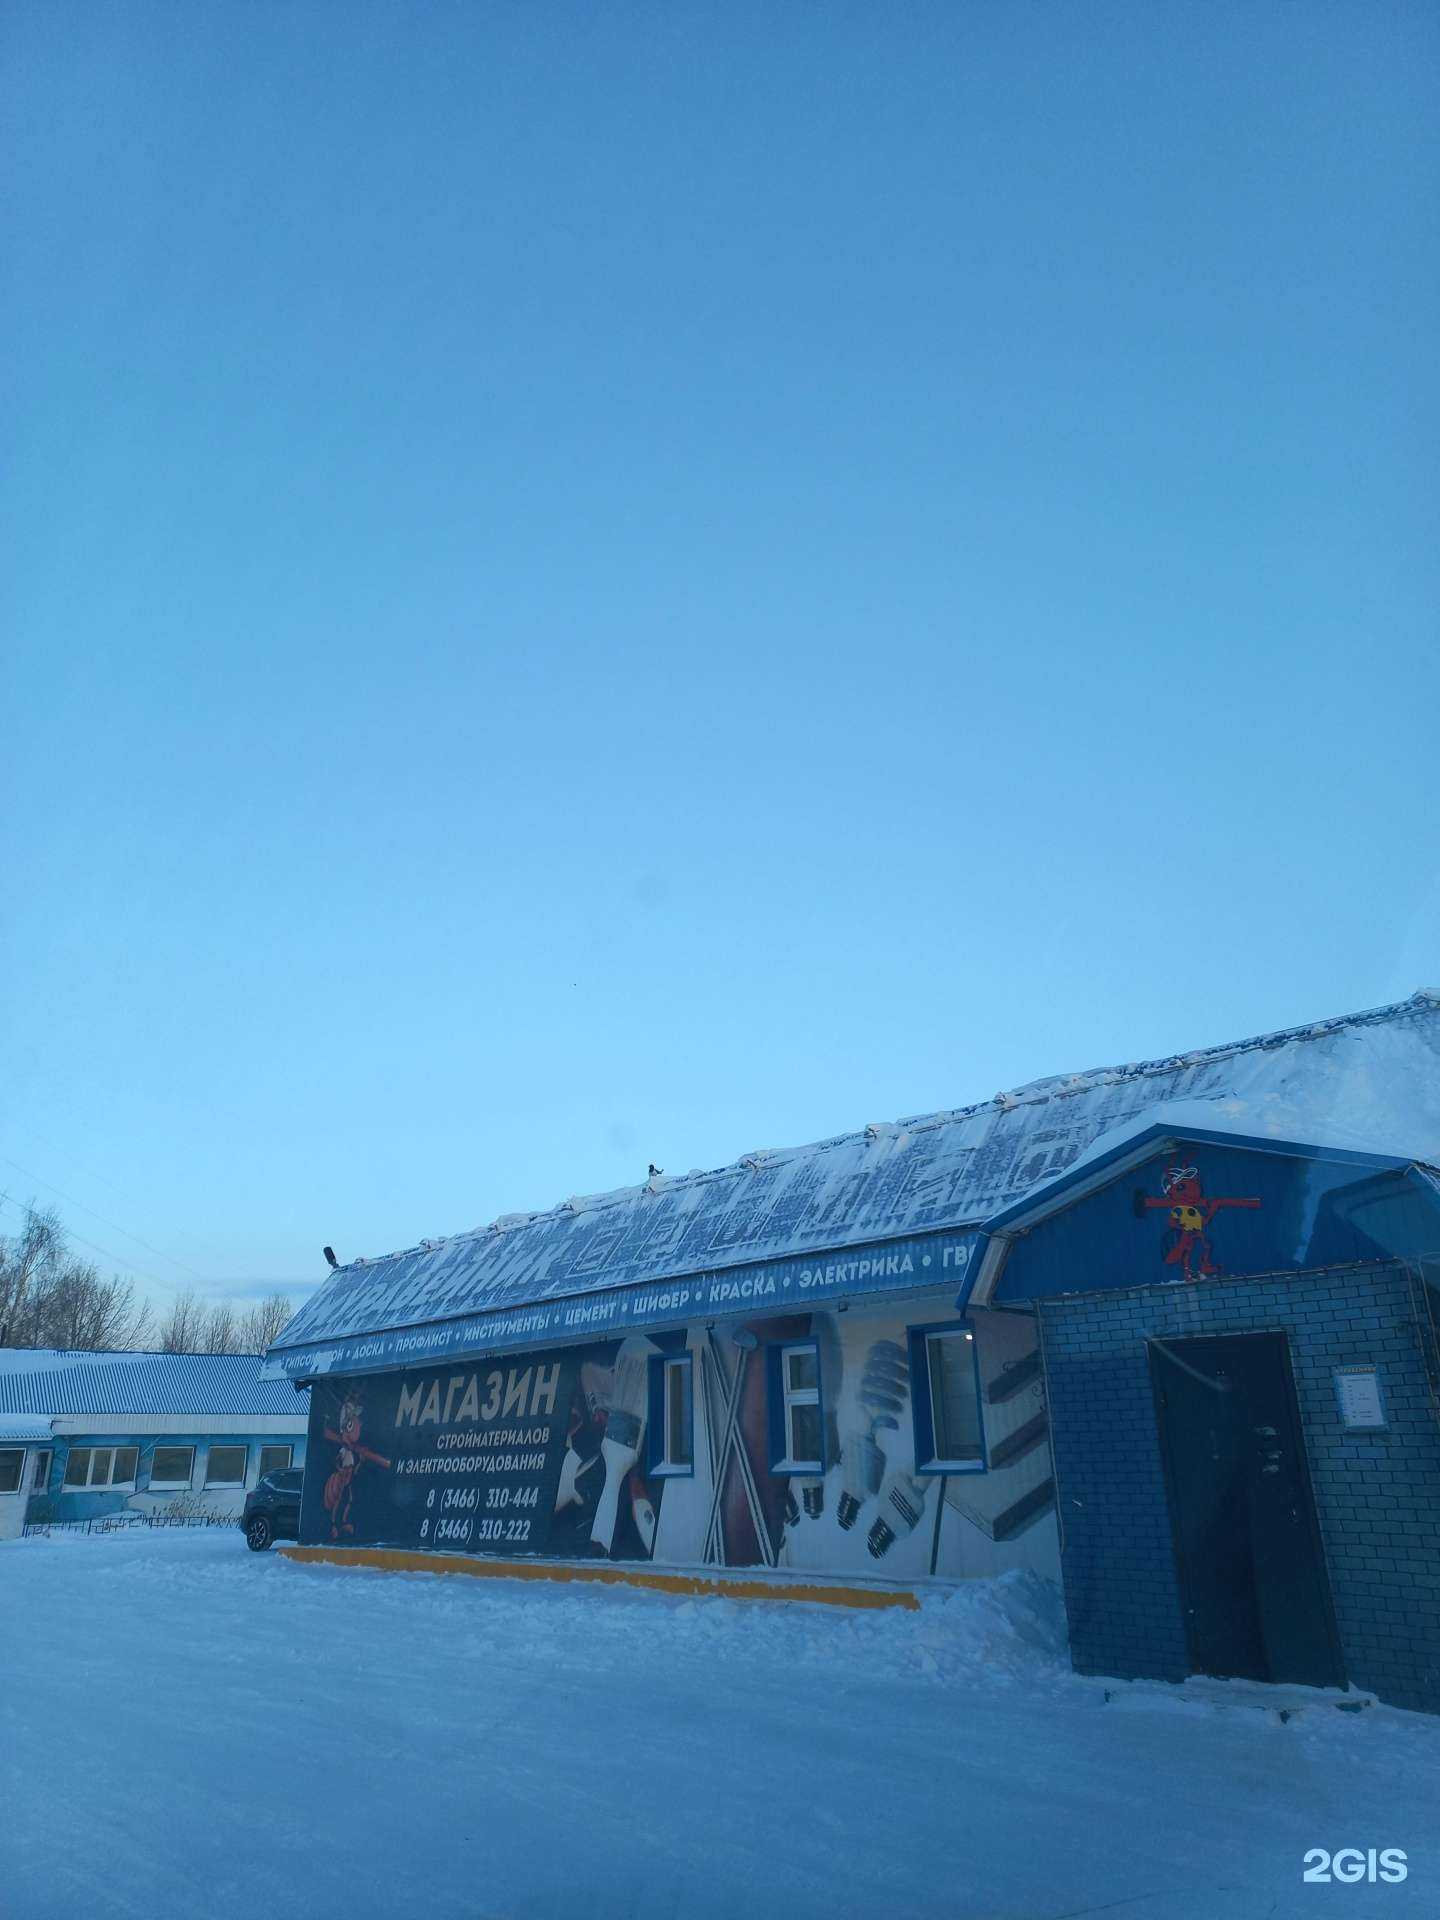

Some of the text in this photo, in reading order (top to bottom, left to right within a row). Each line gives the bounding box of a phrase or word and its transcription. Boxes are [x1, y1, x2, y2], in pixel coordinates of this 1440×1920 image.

[352, 1342, 383, 1360] ДОСКА
[396, 1332, 452, 1352] ПРОФЛИСТ
[463, 1314, 550, 1341] ИНСТРУМЕНТЫ
[565, 1302, 616, 1326] ЦЕМЕНТ
[633, 1290, 690, 1315] ШИФЕР
[709, 1275, 776, 1302] КРАСКА
[799, 1254, 914, 1288] ЭЛЕКТРИКА
[395, 1363, 561, 1427] МАГАЗИН
[437, 1427, 550, 1450] СТРОЙМАТЕРИАЛОВ
[396, 1453, 546, 1474] И ЭЛЕКТРООБОРУДОВАНИЯ
[426, 1487, 539, 1513] 8 (3466) 310-444
[420, 1518, 532, 1545] 8 (3466) 310-222
